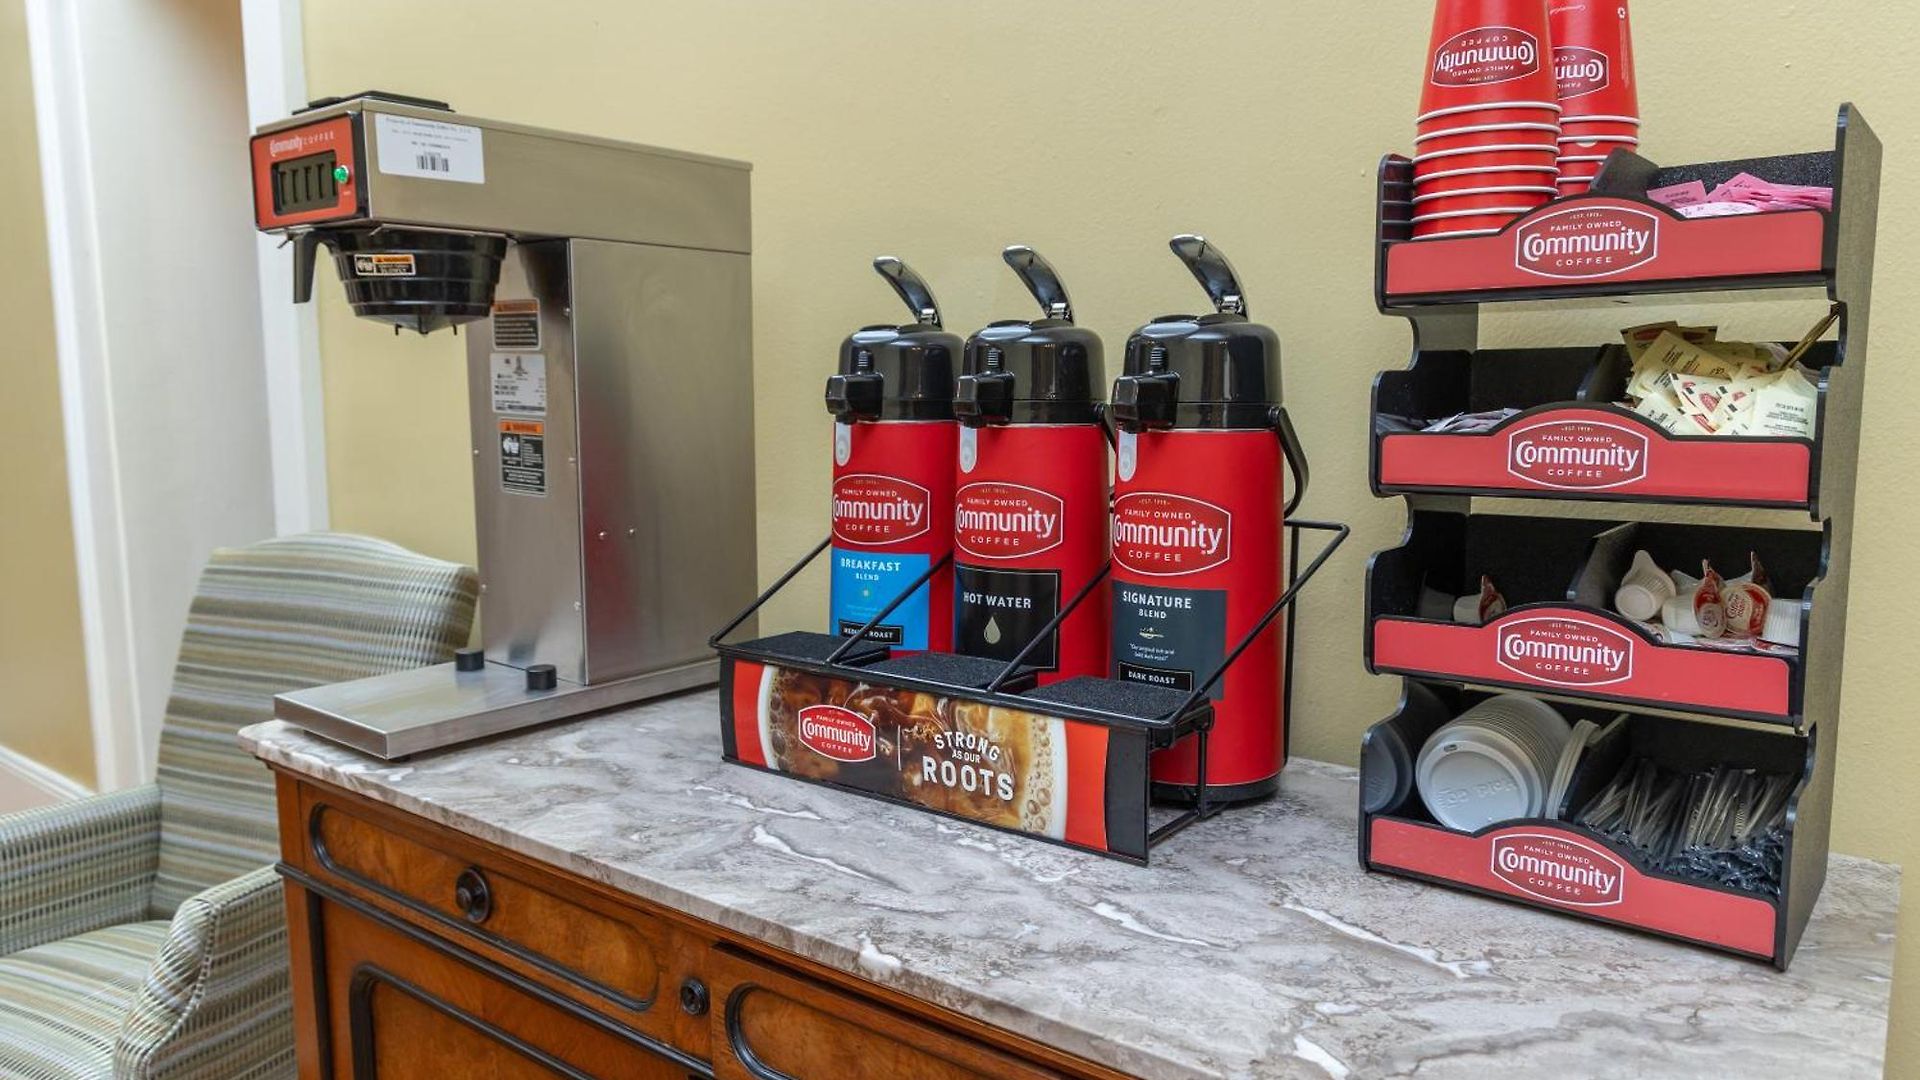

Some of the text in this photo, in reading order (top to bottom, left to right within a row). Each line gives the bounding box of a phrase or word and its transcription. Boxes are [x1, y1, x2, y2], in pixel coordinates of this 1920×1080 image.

[1436, 41, 1534, 73] Community
[1551, 220, 1622, 231] FAMILY OWNED
[1523, 226, 1649, 261] Community
[1556, 256, 1613, 267] COFFEE
[1516, 441, 1639, 472] Community
[1547, 469, 1602, 478] COFFEE
[956, 503, 1056, 539] Community
[1124, 508, 1191, 520] FAMILY OWNED
[845, 524, 890, 533] COFFEE
[1114, 514, 1222, 555] Community
[971, 535, 1020, 547] COFFEE
[1129, 549, 1182, 562] COFFEE
[840, 557, 902, 572] BREAKFAST
[855, 571, 879, 582] BLEND
[963, 591, 1032, 609] HOT WATER
[1122, 590, 1192, 609] SIGNATURE
[1138, 608, 1167, 619] BLEND
[869, 631, 893, 640] ROAST
[1530, 629, 1598, 643] FAMILY OWNED
[1504, 634, 1625, 671] Community
[1535, 662, 1590, 676] COFFEE
[1128, 670, 1175, 685] DARK ROAST
[802, 717, 872, 753] Community
[821, 741, 853, 754] COFFEE
[934, 731, 1000, 761] STRONG
[952, 749, 981, 764] AS OUR
[922, 755, 1014, 801] ROOTS
[1523, 845, 1554, 856] FAMILY
[1557, 852, 1590, 865] OWNED
[1499, 846, 1616, 895] Community
[1529, 877, 1582, 897] COFFEE
